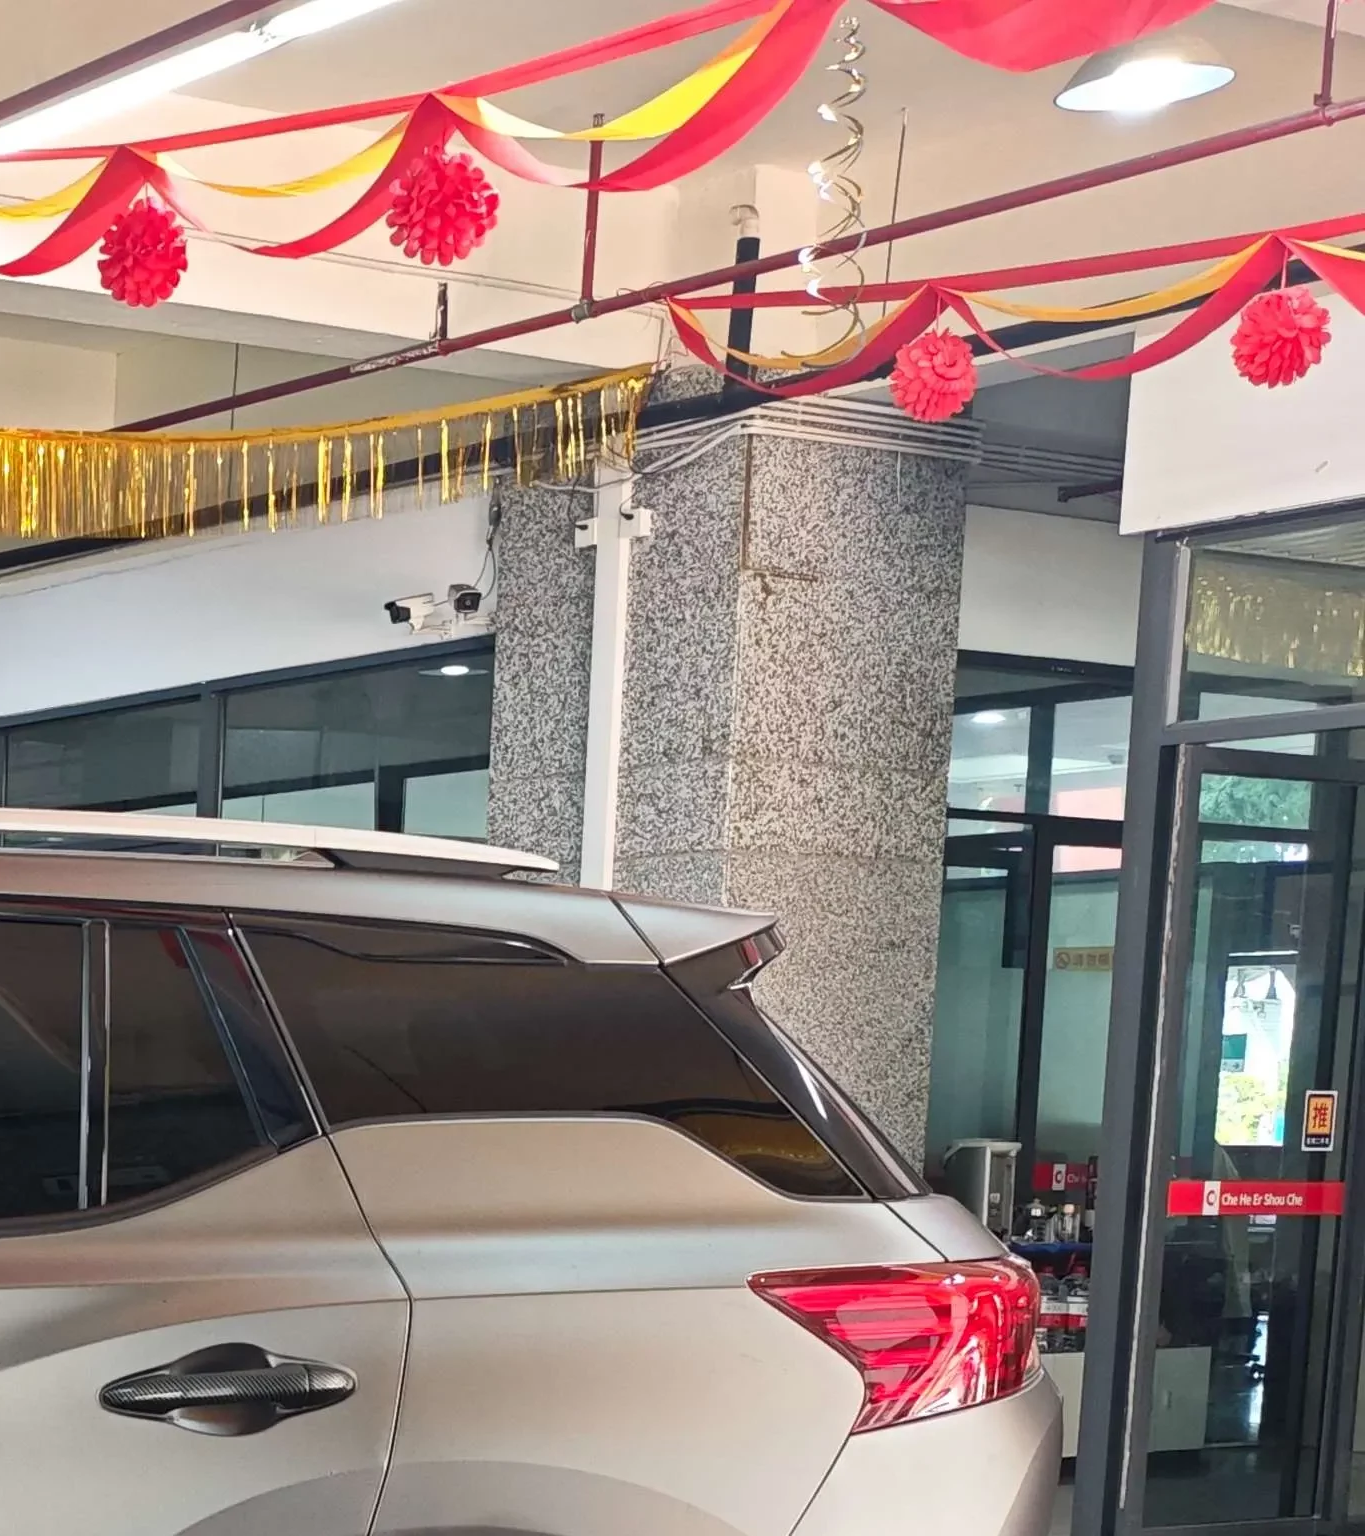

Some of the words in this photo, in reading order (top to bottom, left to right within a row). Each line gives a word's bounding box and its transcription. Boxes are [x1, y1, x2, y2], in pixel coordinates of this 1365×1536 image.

[1312, 1102, 1330, 1129] 推
[1221, 1192, 1238, 1206] Che
[1239, 1192, 1252, 1206] He
[1252, 1192, 1263, 1206] Er
[1263, 1192, 1285, 1206] Shou
[1286, 1192, 1303, 1206] Che
